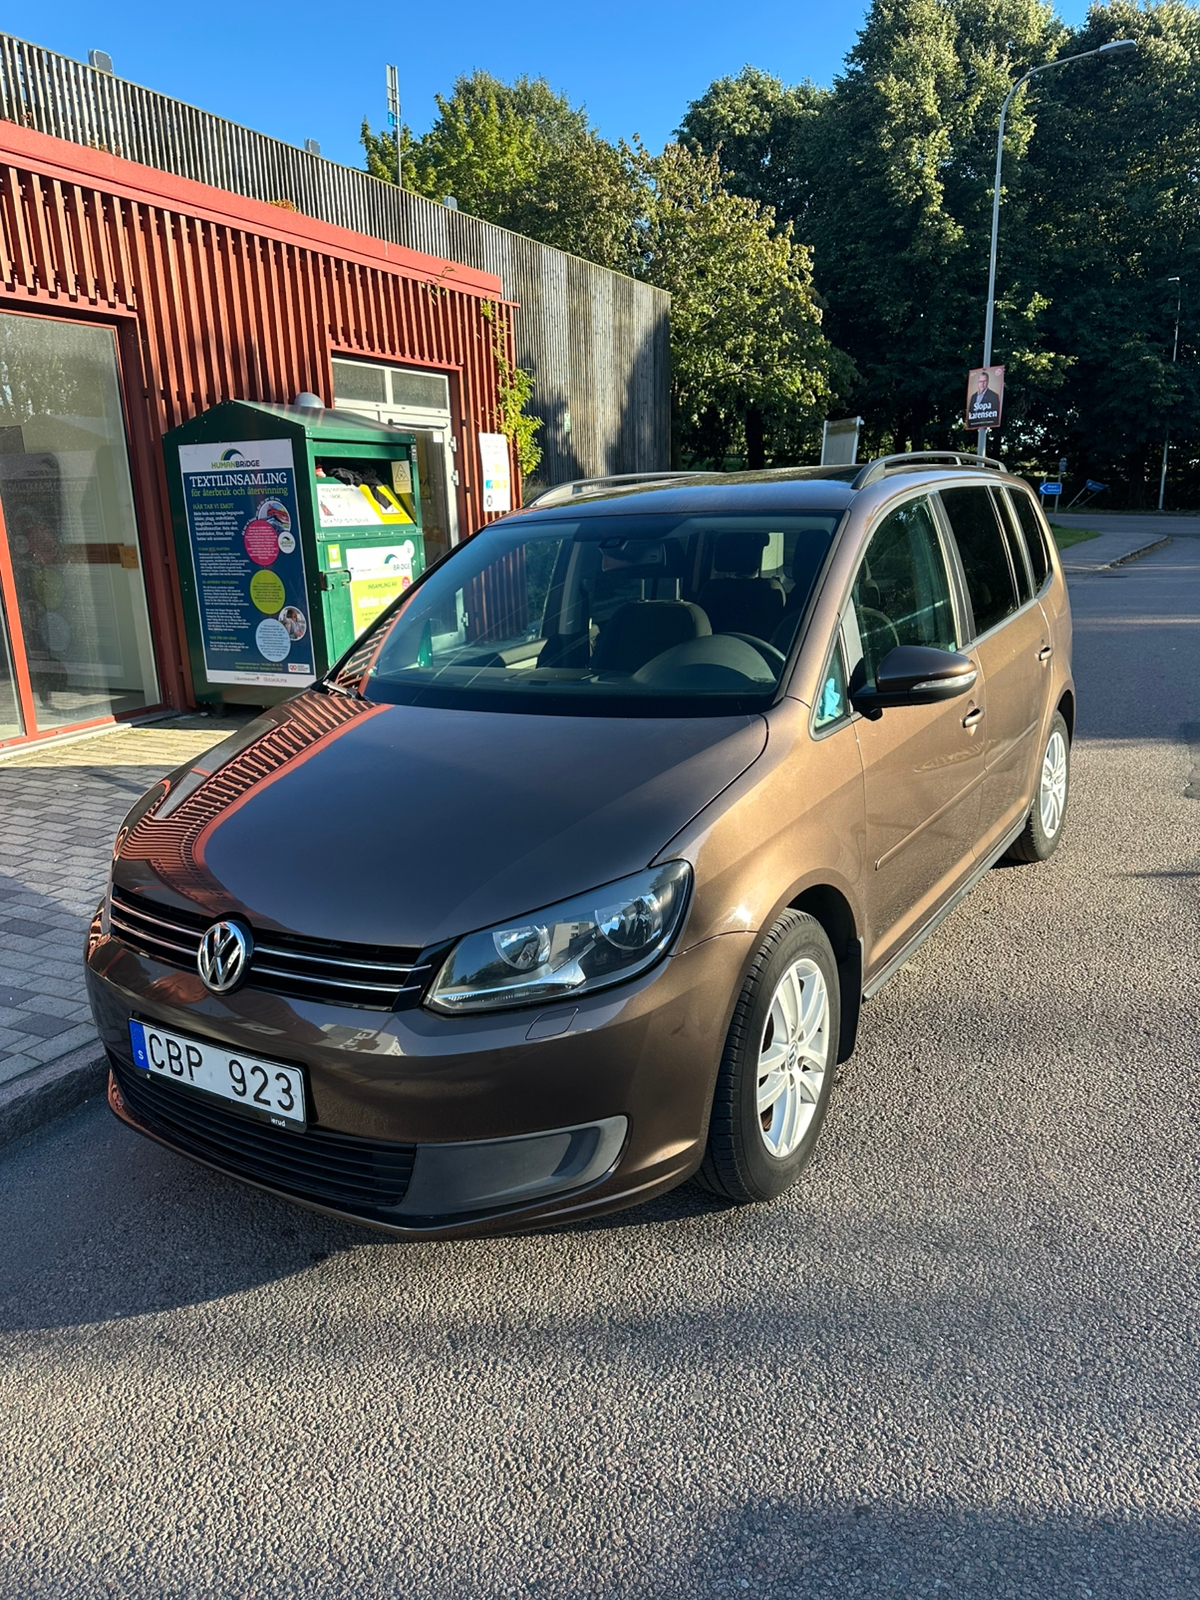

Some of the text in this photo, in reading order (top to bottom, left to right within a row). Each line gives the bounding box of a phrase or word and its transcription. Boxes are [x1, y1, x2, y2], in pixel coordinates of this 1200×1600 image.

[189, 472, 288, 487] TEXTILINSAMLING
[191, 486, 288, 497] för återbruk och återvinning
[138, 1050, 144, 1060] S
[149, 1033, 295, 1112] CBP 923
